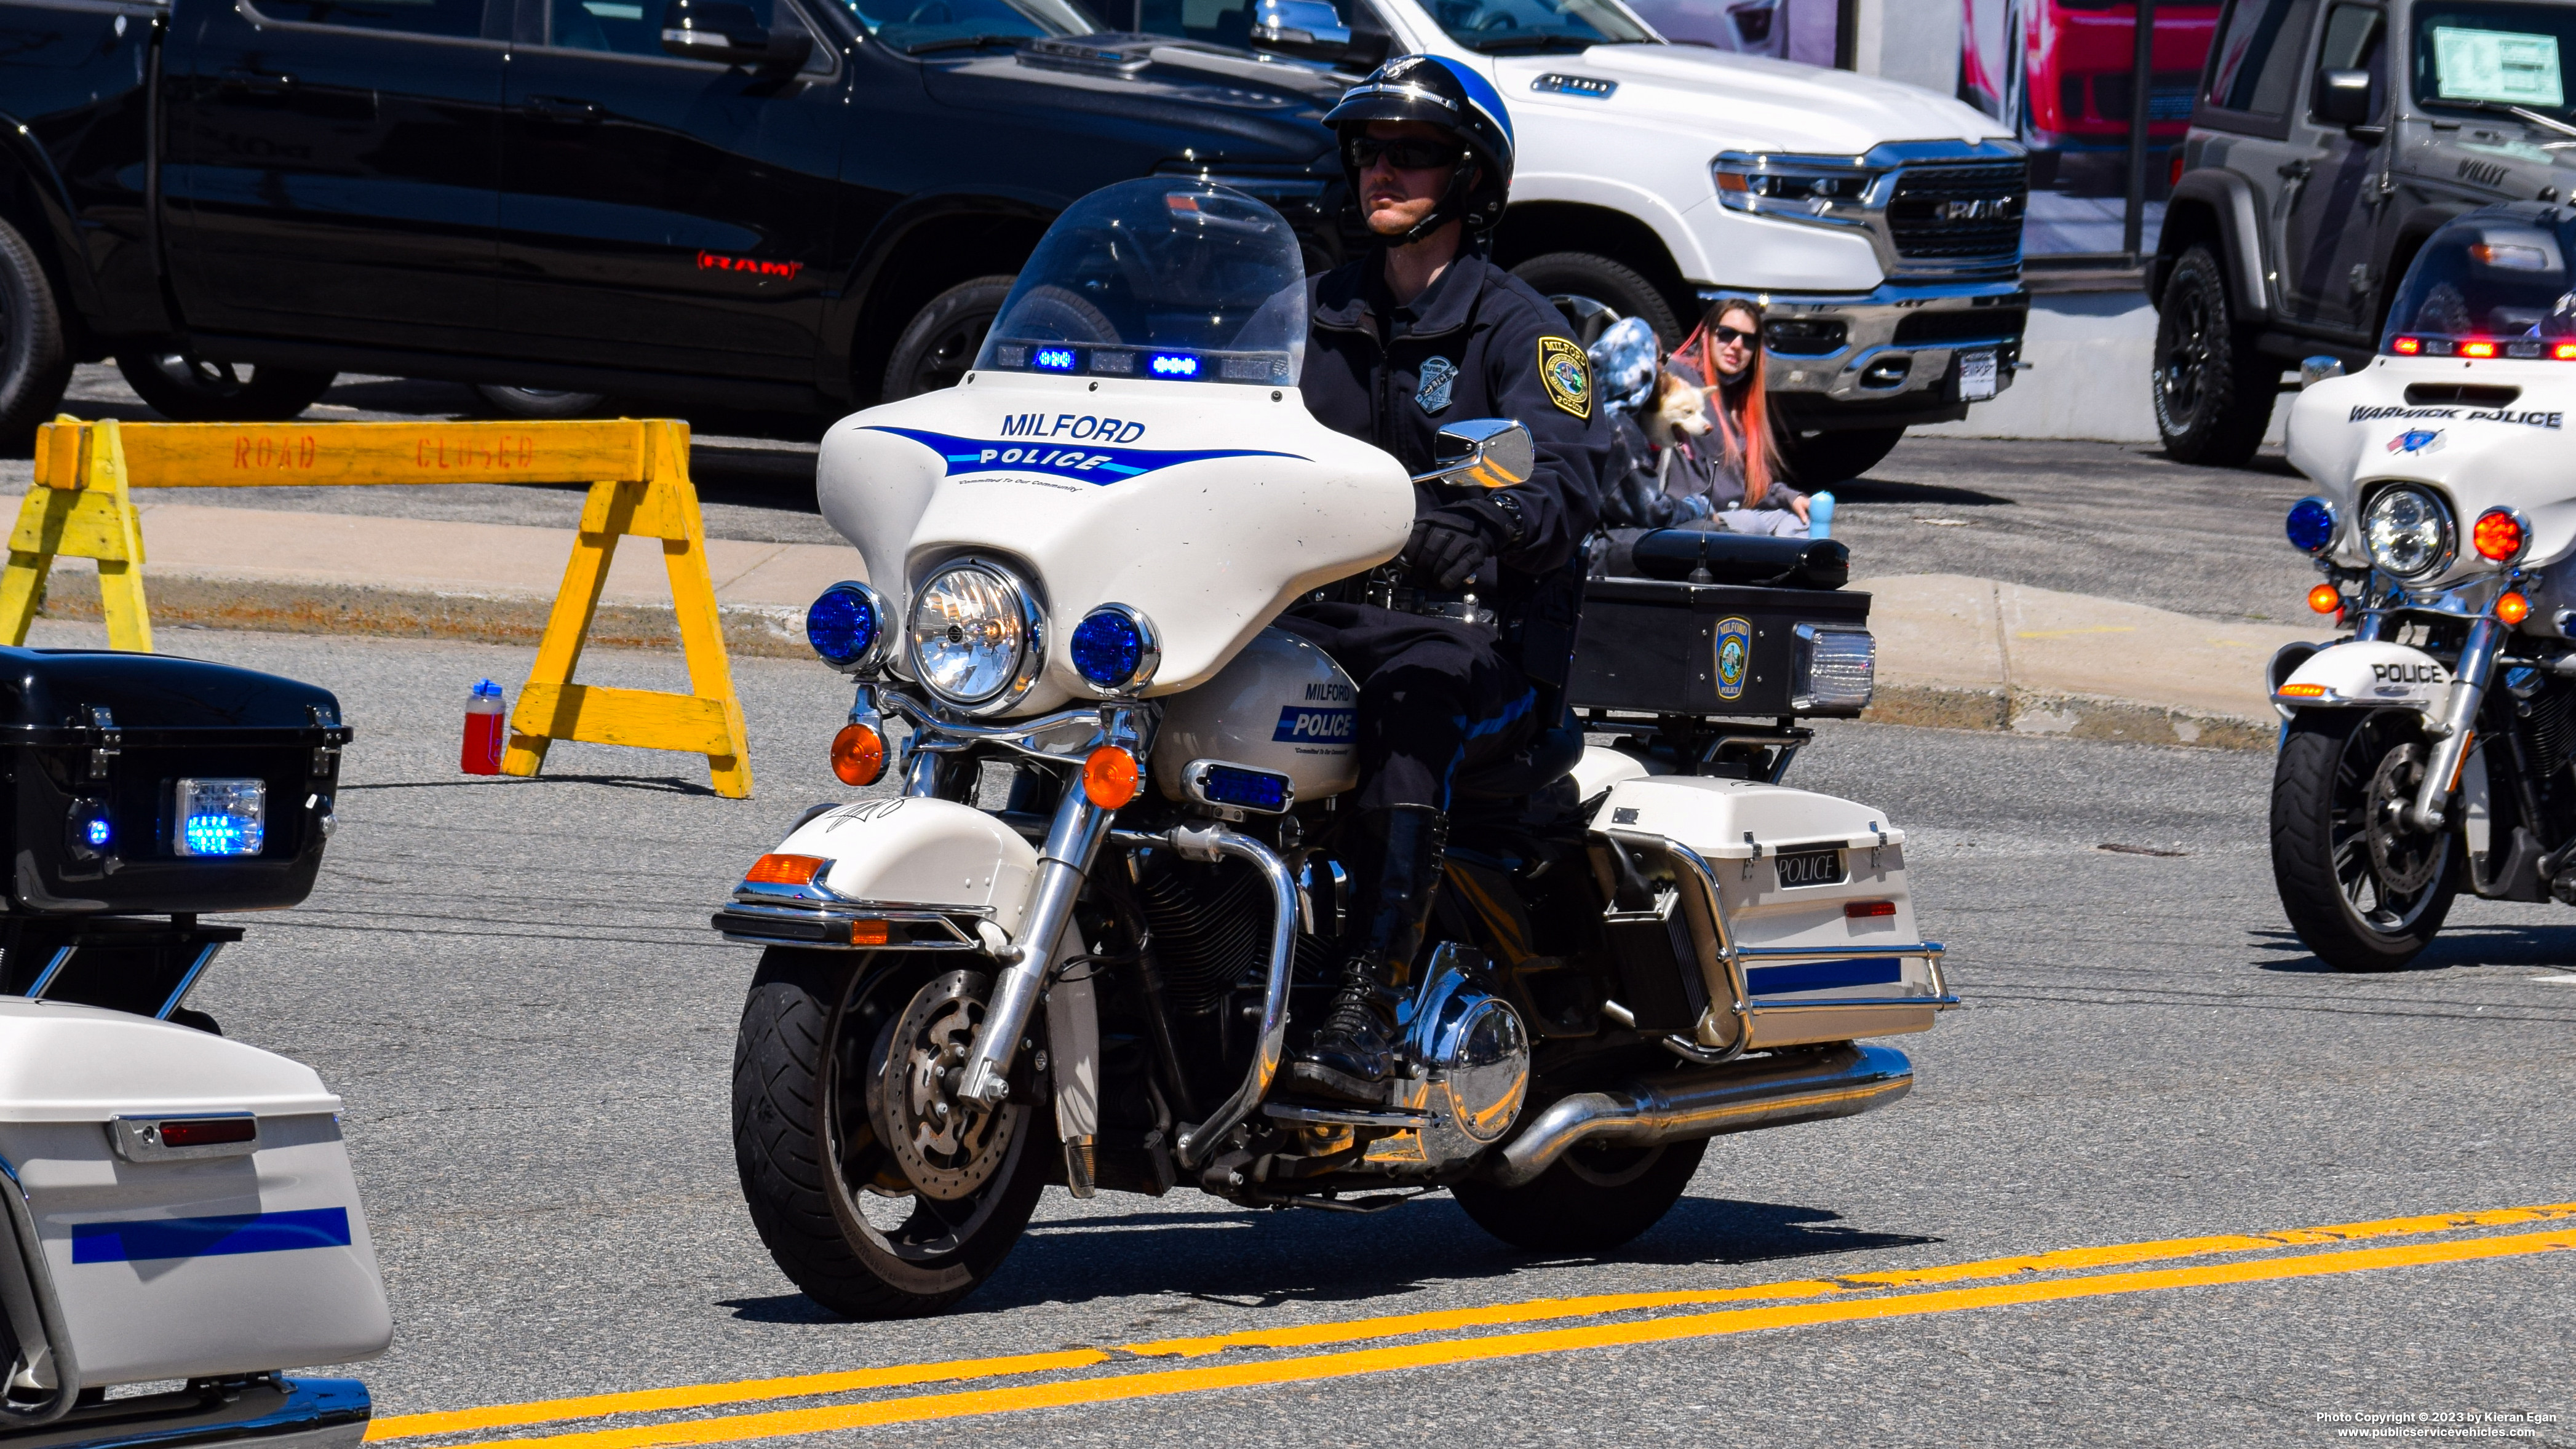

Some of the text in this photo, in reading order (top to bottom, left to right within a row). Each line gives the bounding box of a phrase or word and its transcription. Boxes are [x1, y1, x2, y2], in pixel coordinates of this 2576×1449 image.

[2458, 157, 2511, 186] WILLYS
[1947, 200, 2006, 220] RAM
[704, 255, 789, 276] RAM
[1544, 341, 1586, 366] MILFORD
[1557, 395, 1583, 413] POLICE
[1000, 413, 1145, 443] MILFORD
[2348, 405, 2564, 429] WARWICK POLICE
[234, 435, 533, 469] ROAD CLOSED
[980, 448, 1113, 470] POLICE
[1720, 622, 1747, 636] MILFORD
[2371, 664, 2444, 683] POLICE
[1305, 683, 1350, 701] MILFORD
[1293, 713, 1352, 737] POLICE
[1779, 856, 1834, 882] POLICE
